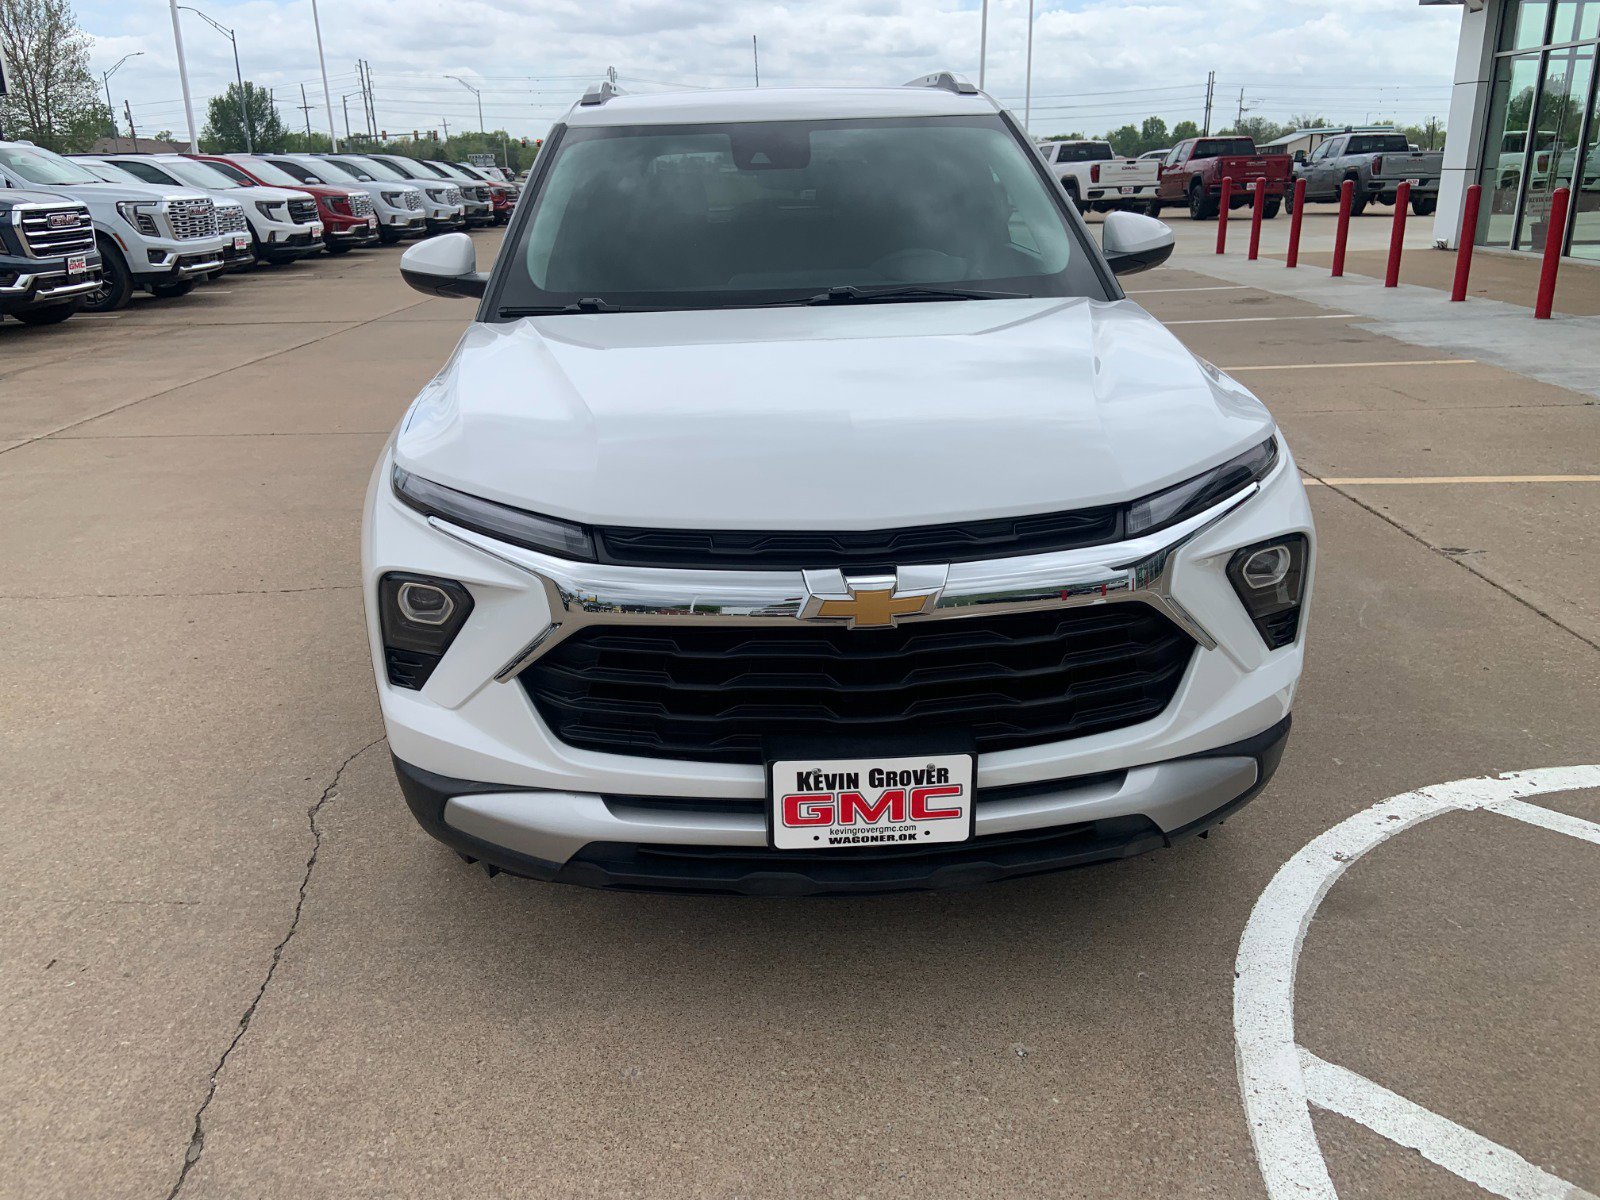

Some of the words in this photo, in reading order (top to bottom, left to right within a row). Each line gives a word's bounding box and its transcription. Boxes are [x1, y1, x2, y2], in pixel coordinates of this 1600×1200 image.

[51, 214, 80, 226] GMC
[69, 261, 86, 270] GMC
[796, 771, 860, 792] KEVIN
[868, 767, 950, 788] GROVER
[781, 783, 963, 828] GMC
[829, 824, 917, 836] kevingrovergmc.com
